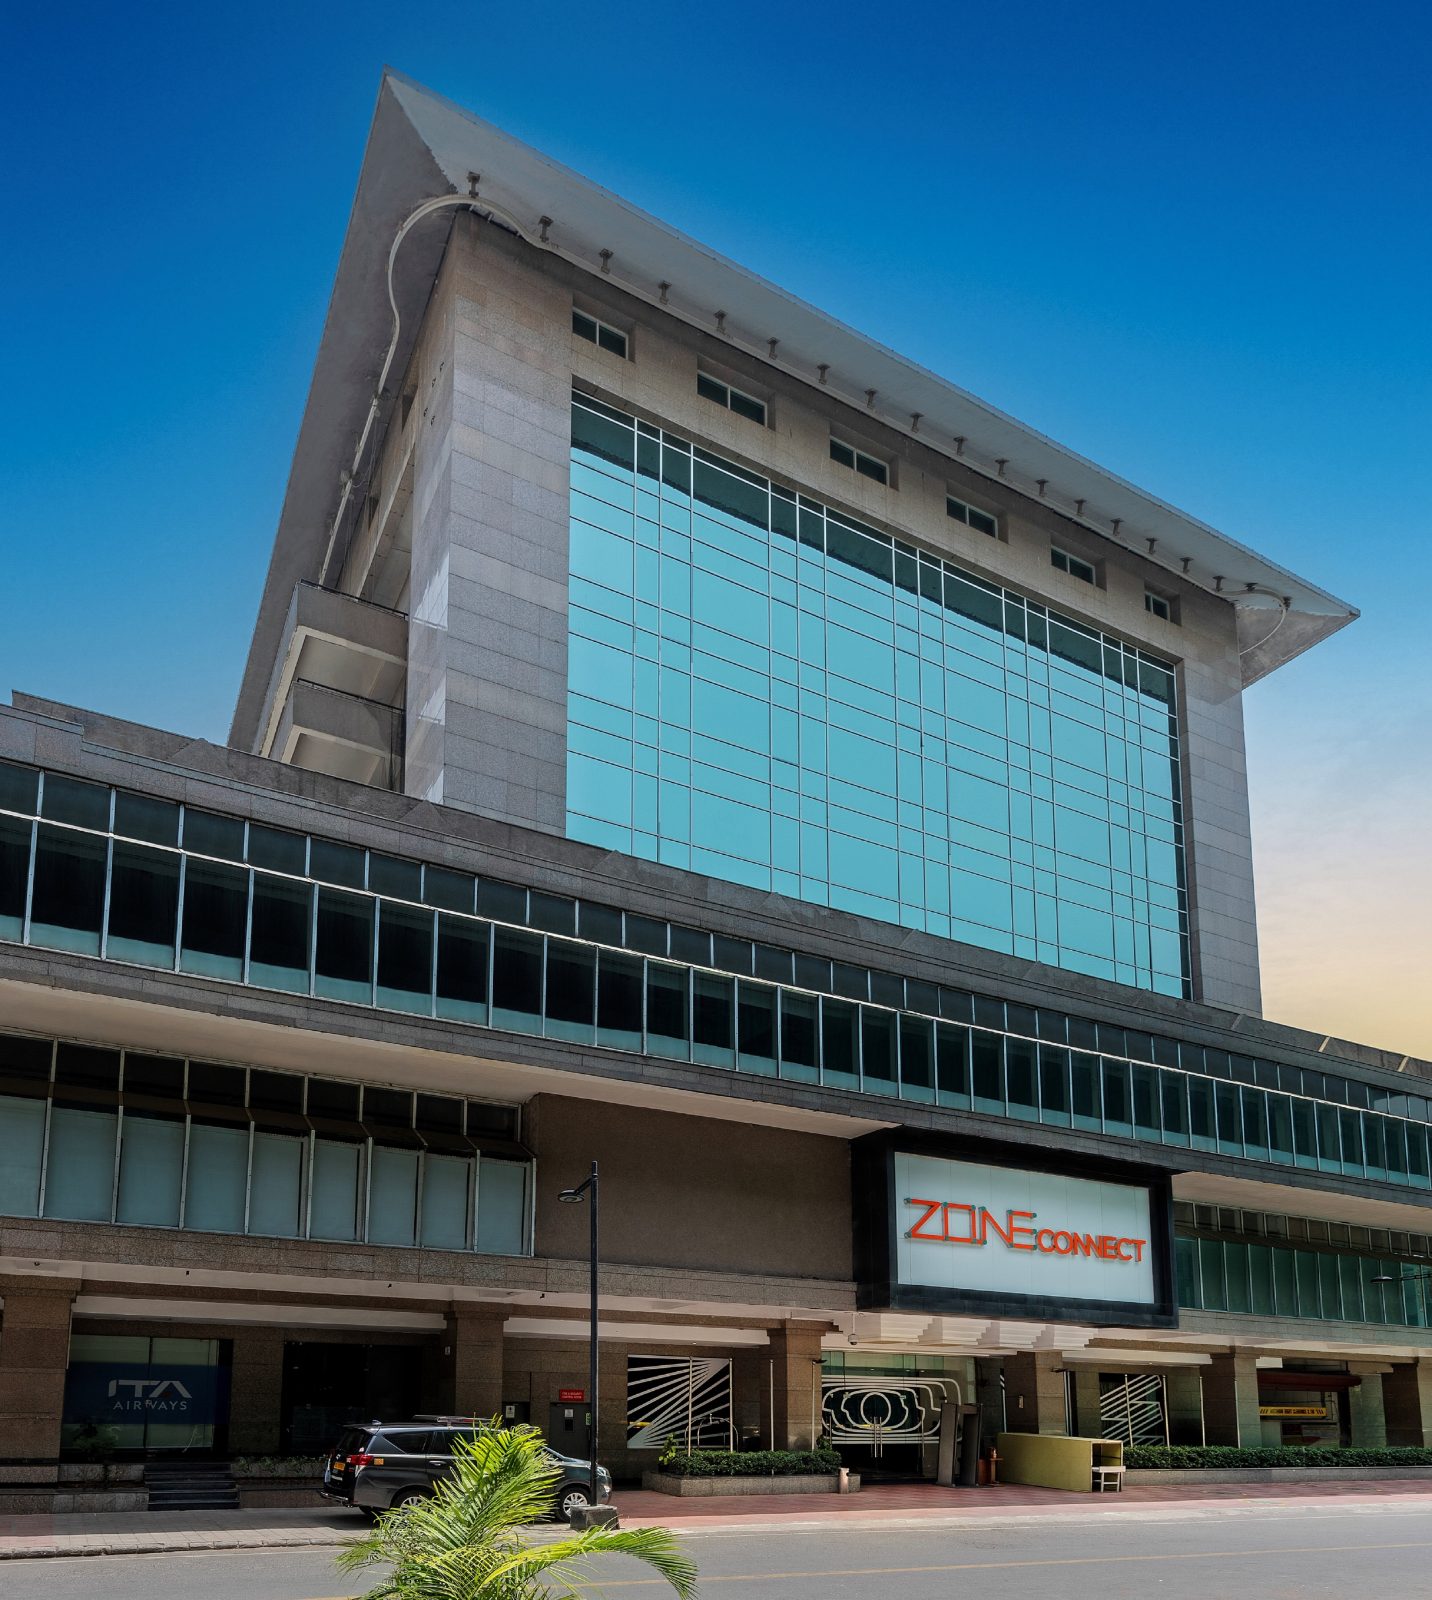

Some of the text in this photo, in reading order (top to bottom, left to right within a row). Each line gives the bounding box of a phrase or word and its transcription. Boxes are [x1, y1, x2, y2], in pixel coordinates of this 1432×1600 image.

[904, 1197, 1146, 1262] ZONE CONNECT
[108, 1379, 193, 1398] ITA
[113, 1400, 187, 1411] AIRWAYS
